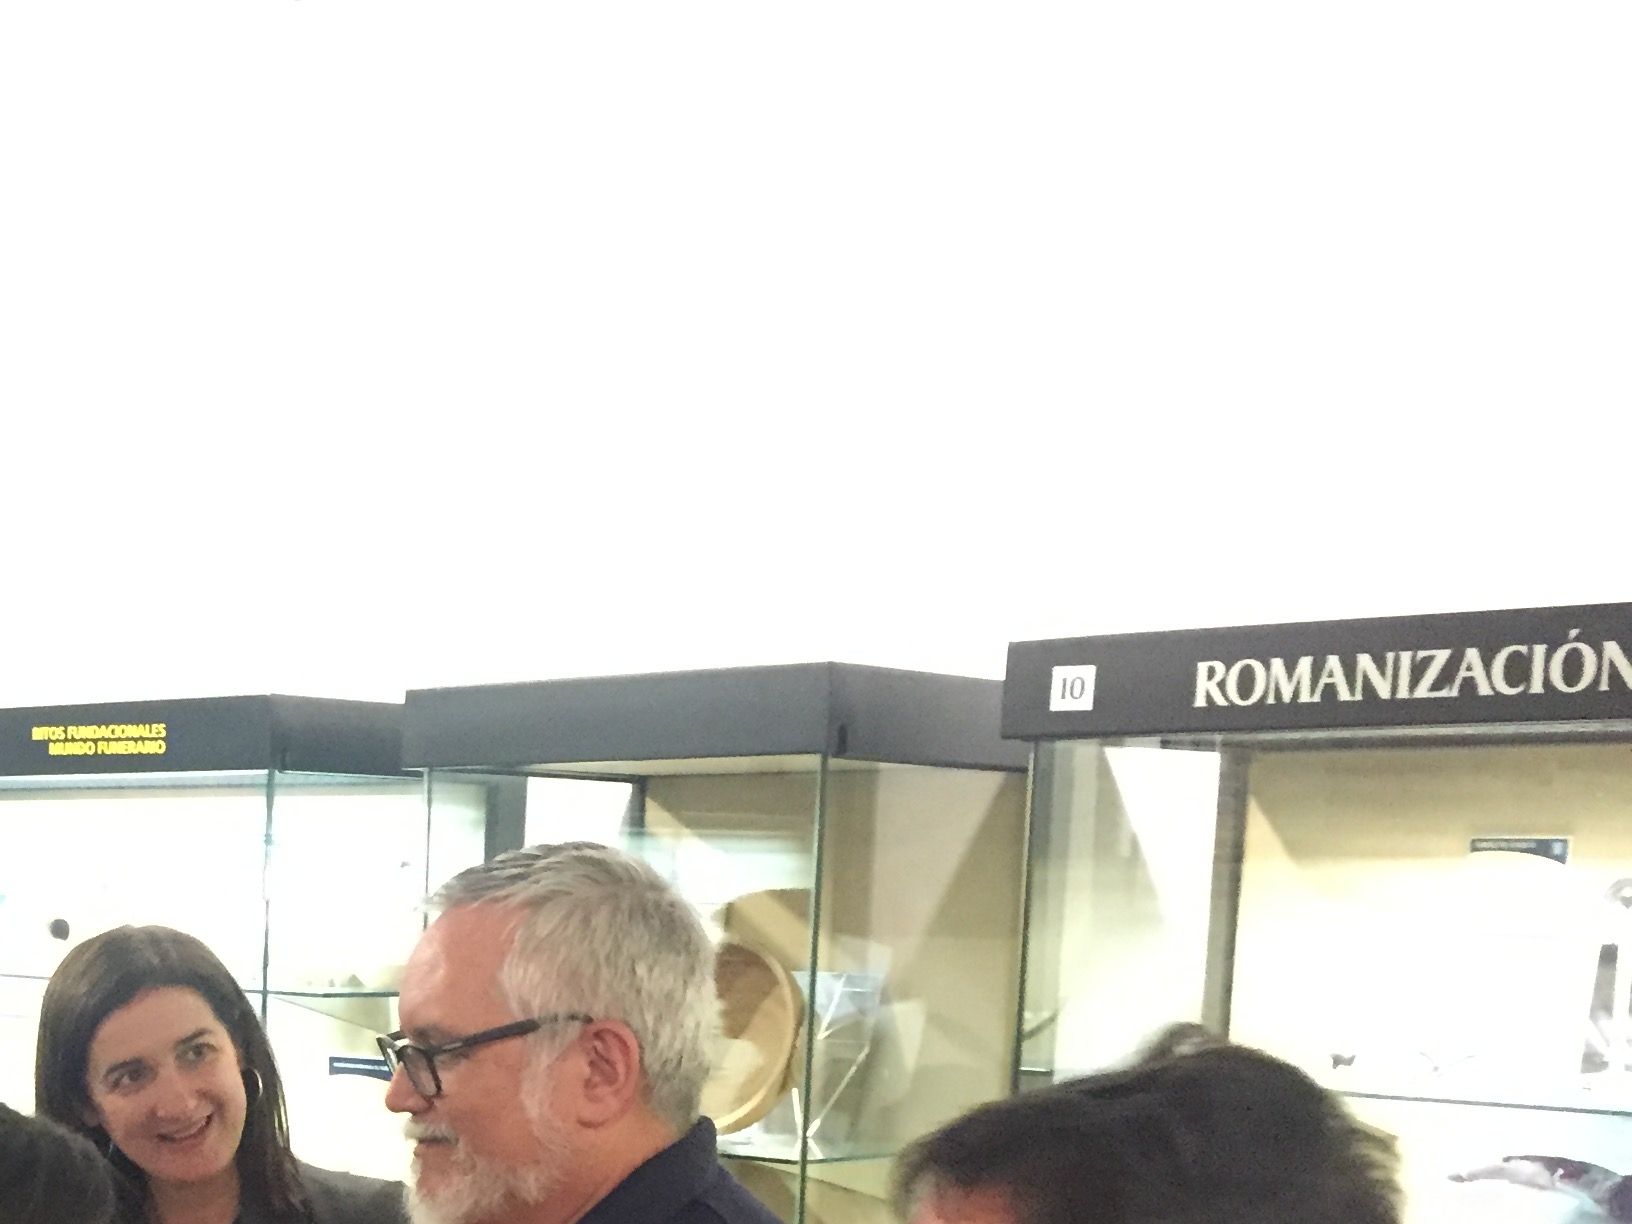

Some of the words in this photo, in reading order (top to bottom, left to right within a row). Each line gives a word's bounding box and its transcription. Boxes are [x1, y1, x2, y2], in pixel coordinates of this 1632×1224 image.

[1192, 628, 1632, 708] ROMANIZACIÓN
[1060, 676, 1086, 700] 10
[67, 723, 167, 739] FUNDACIONALES
[49, 741, 96, 755] MUNDO
[97, 740, 167, 755] FUNERARIO
